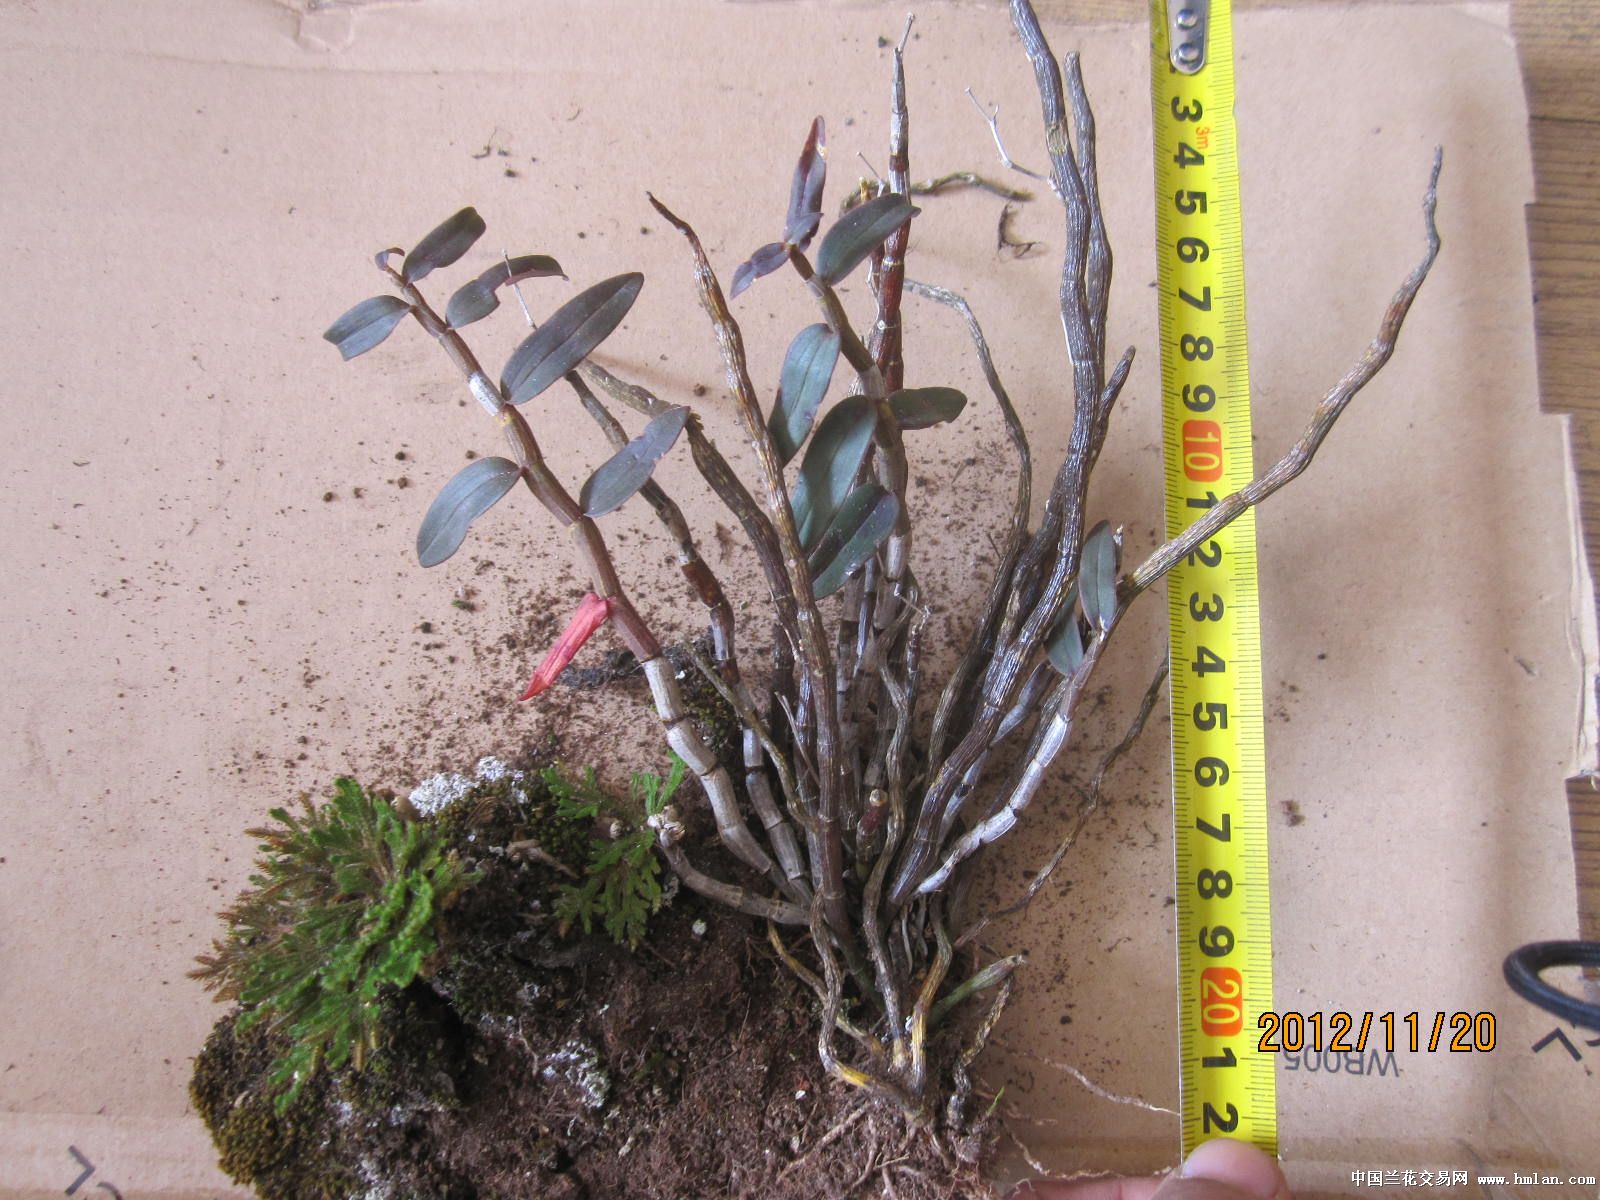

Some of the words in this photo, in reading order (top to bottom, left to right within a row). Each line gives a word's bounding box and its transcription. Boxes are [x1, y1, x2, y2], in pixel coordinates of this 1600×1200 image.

[1170, 96, 1203, 122] 3
[1195, 126, 1211, 150] 3m
[1174, 142, 1205, 169] 4
[1174, 189, 1208, 215] 5
[1176, 237, 1210, 263] 6
[1178, 286, 1211, 311] 7
[1180, 334, 1214, 362] 8
[1182, 384, 1216, 412] 9
[1184, 432, 1220, 470] 10
[1190, 592, 1224, 622] 3
[1192, 646, 1226, 677] 4
[1193, 702, 1228, 732] 5
[1194, 757, 1230, 788] 6
[1196, 814, 1231, 842] 7
[1197, 868, 1232, 900] 8
[1199, 926, 1235, 958] 9
[1202, 979, 1240, 1024] 20
[1202, 1047, 1237, 1068] 1
[1283, 1044, 1400, 1078] WB005
[1202, 1102, 1239, 1134] 2
